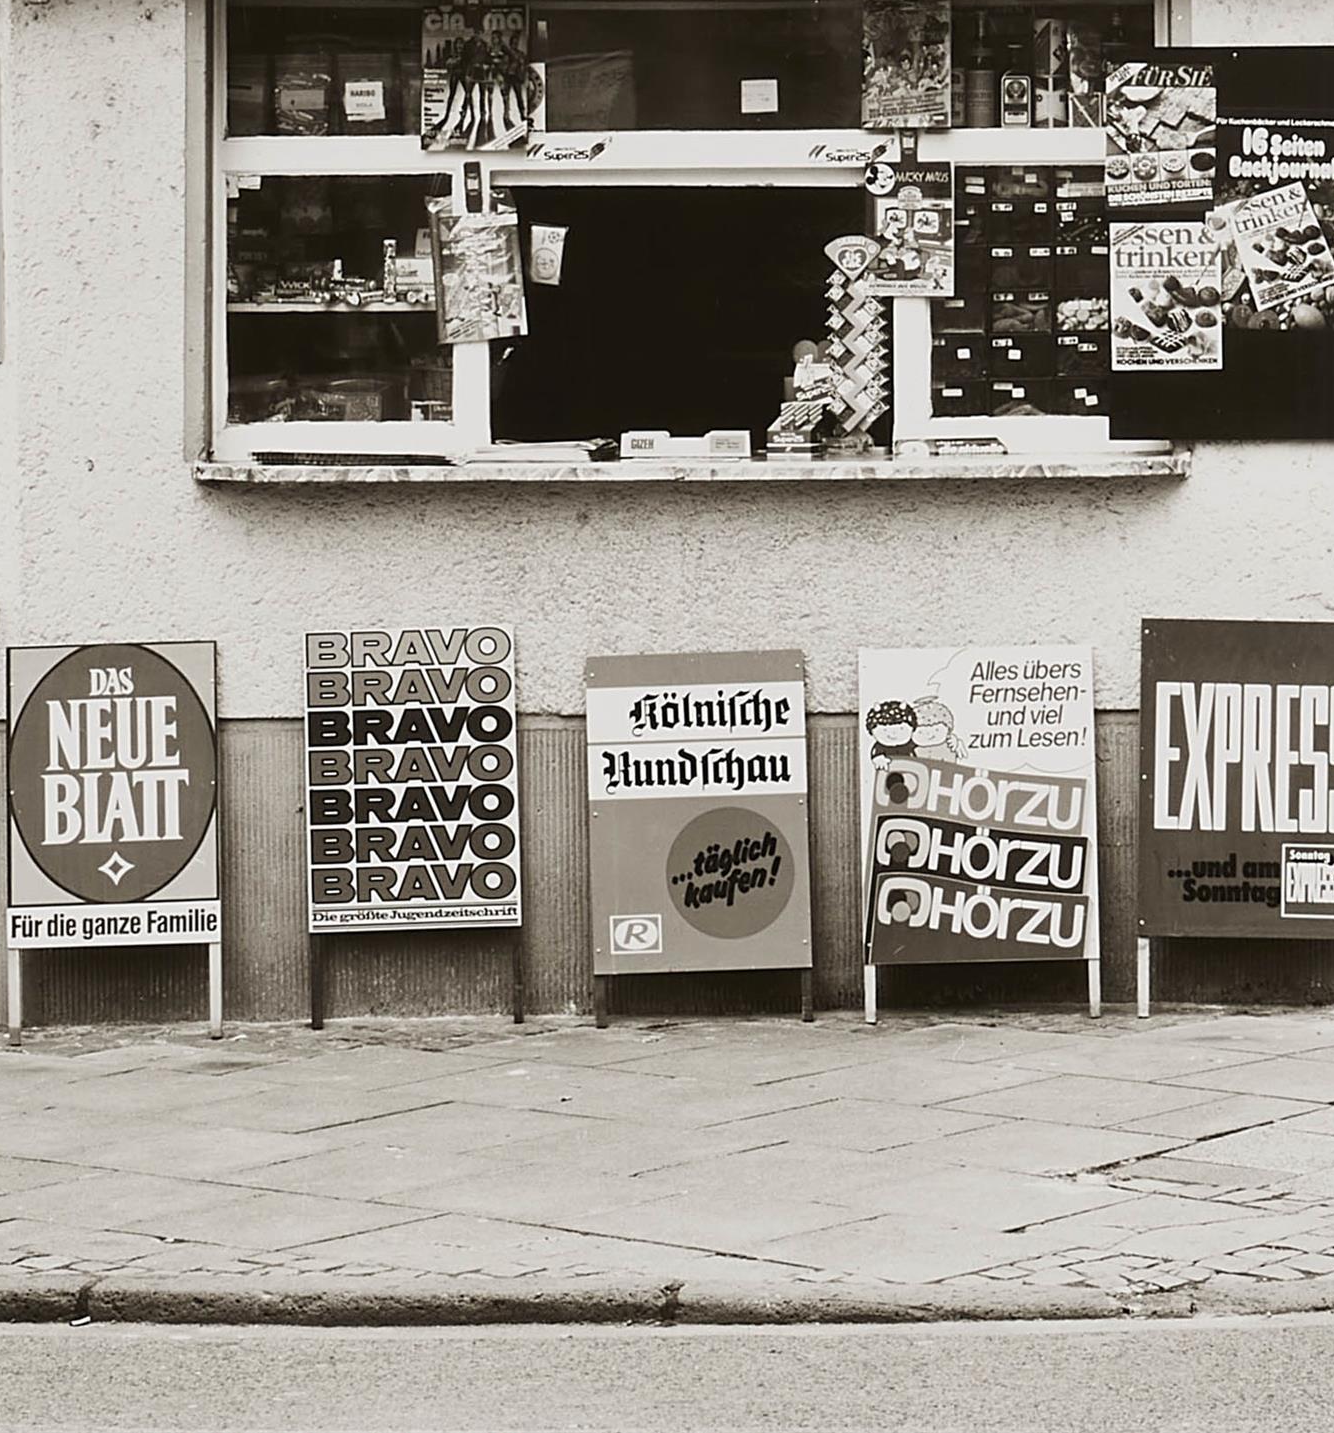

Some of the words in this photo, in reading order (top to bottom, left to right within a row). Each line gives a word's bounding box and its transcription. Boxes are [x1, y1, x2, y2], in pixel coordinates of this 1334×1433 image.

[1130, 65, 1175, 86] FÜR
[1242, 127, 1269, 156] 16
[1269, 133, 1326, 157] Seiten
[305, 627, 512, 669] BRAVO
[88, 666, 135, 698] DAS
[970, 661, 1019, 681] Alles
[1022, 660, 1082, 680] übers
[305, 666, 513, 708] BRAVO
[969, 683, 1088, 704] Fernsehen-
[307, 704, 514, 747] BRAVO
[987, 707, 1027, 727] und
[1031, 704, 1064, 725] viel
[45, 694, 181, 772] NEUE
[968, 731, 1014, 750] zum
[1017, 726, 1087, 749] Lesen!
[308, 743, 515, 787] BRAVO
[39, 768, 190, 847] BLATT
[309, 783, 516, 826] BRAVO
[310, 822, 517, 866] BRAVO
[1289, 849, 1331, 864] Sonntag
[311, 861, 518, 904] BRAVO
[683, 855, 782, 910] kaufen!
[1242, 857, 1281, 879] am
[1182, 878, 1281, 908] Sonntag
[10, 915, 42, 940] Für
[46, 913, 78, 938] die
[81, 916, 142, 941] ganze
[146, 909, 218, 935] Familie
[311, 911, 337, 924] Die
[390, 905, 519, 923] Jugendzeitschrift
[623, 922, 649, 946] R
